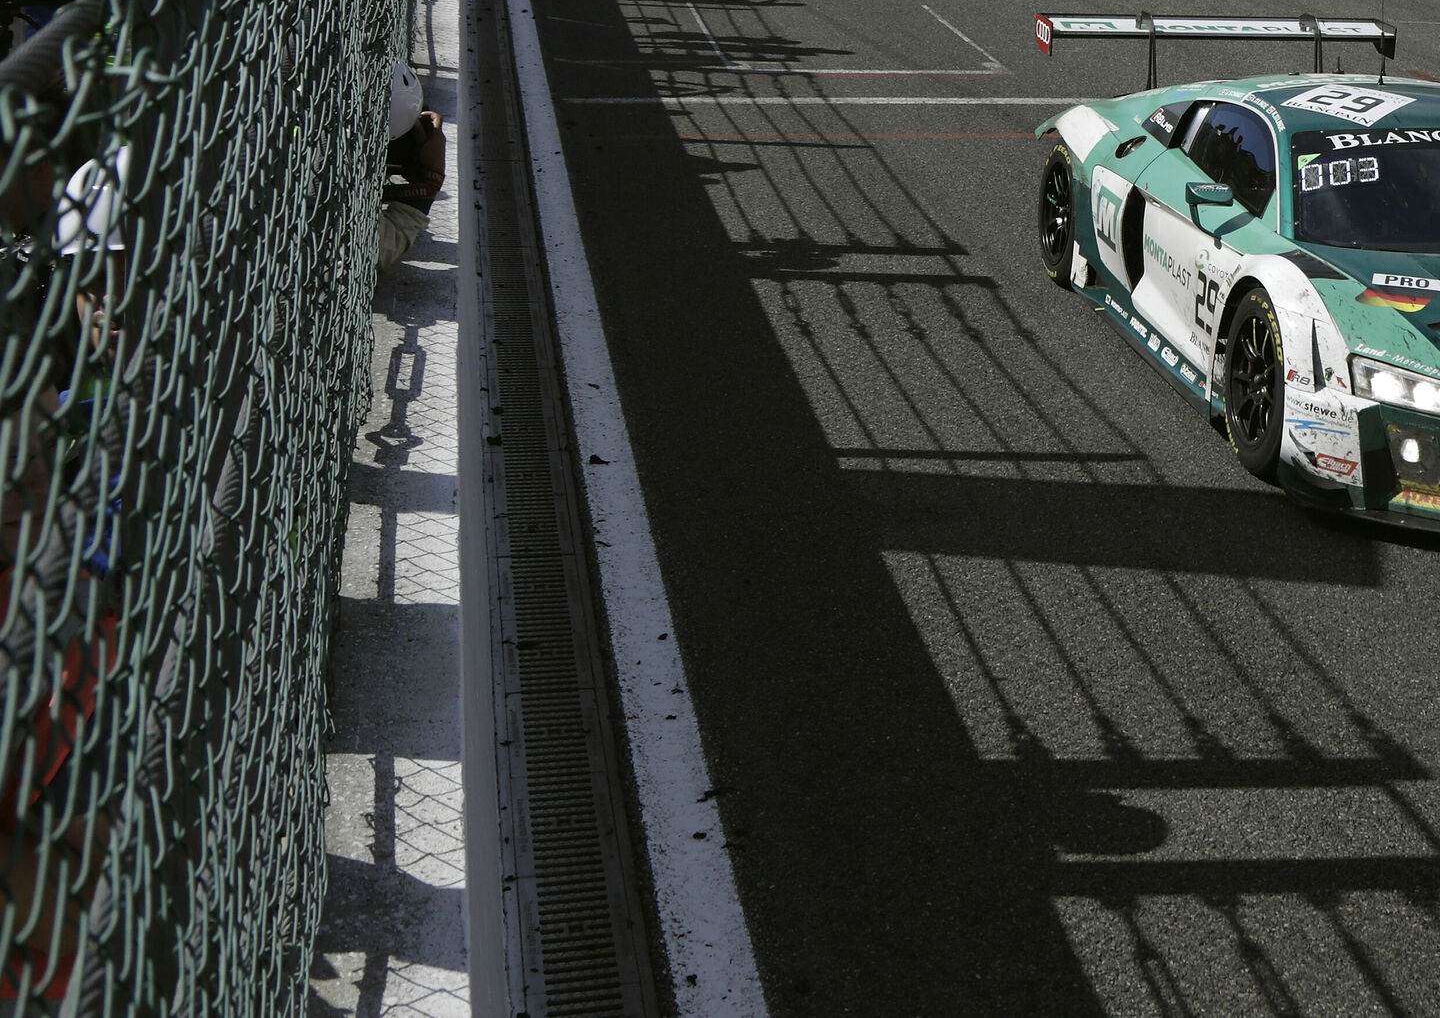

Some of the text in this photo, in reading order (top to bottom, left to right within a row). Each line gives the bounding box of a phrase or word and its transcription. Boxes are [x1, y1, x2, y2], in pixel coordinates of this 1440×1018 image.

[1285, 101, 1374, 125] BLANCPAIN
[1307, 90, 1385, 114] 29
[1301, 157, 1379, 191] 003
[1143, 234, 1191, 290] MONTAPLAST
[1207, 263, 1229, 279] COYOT
[1384, 275, 1430, 288] PRO
[1262, 302, 1283, 362] P ZERO
[1288, 370, 1310, 385] R8
